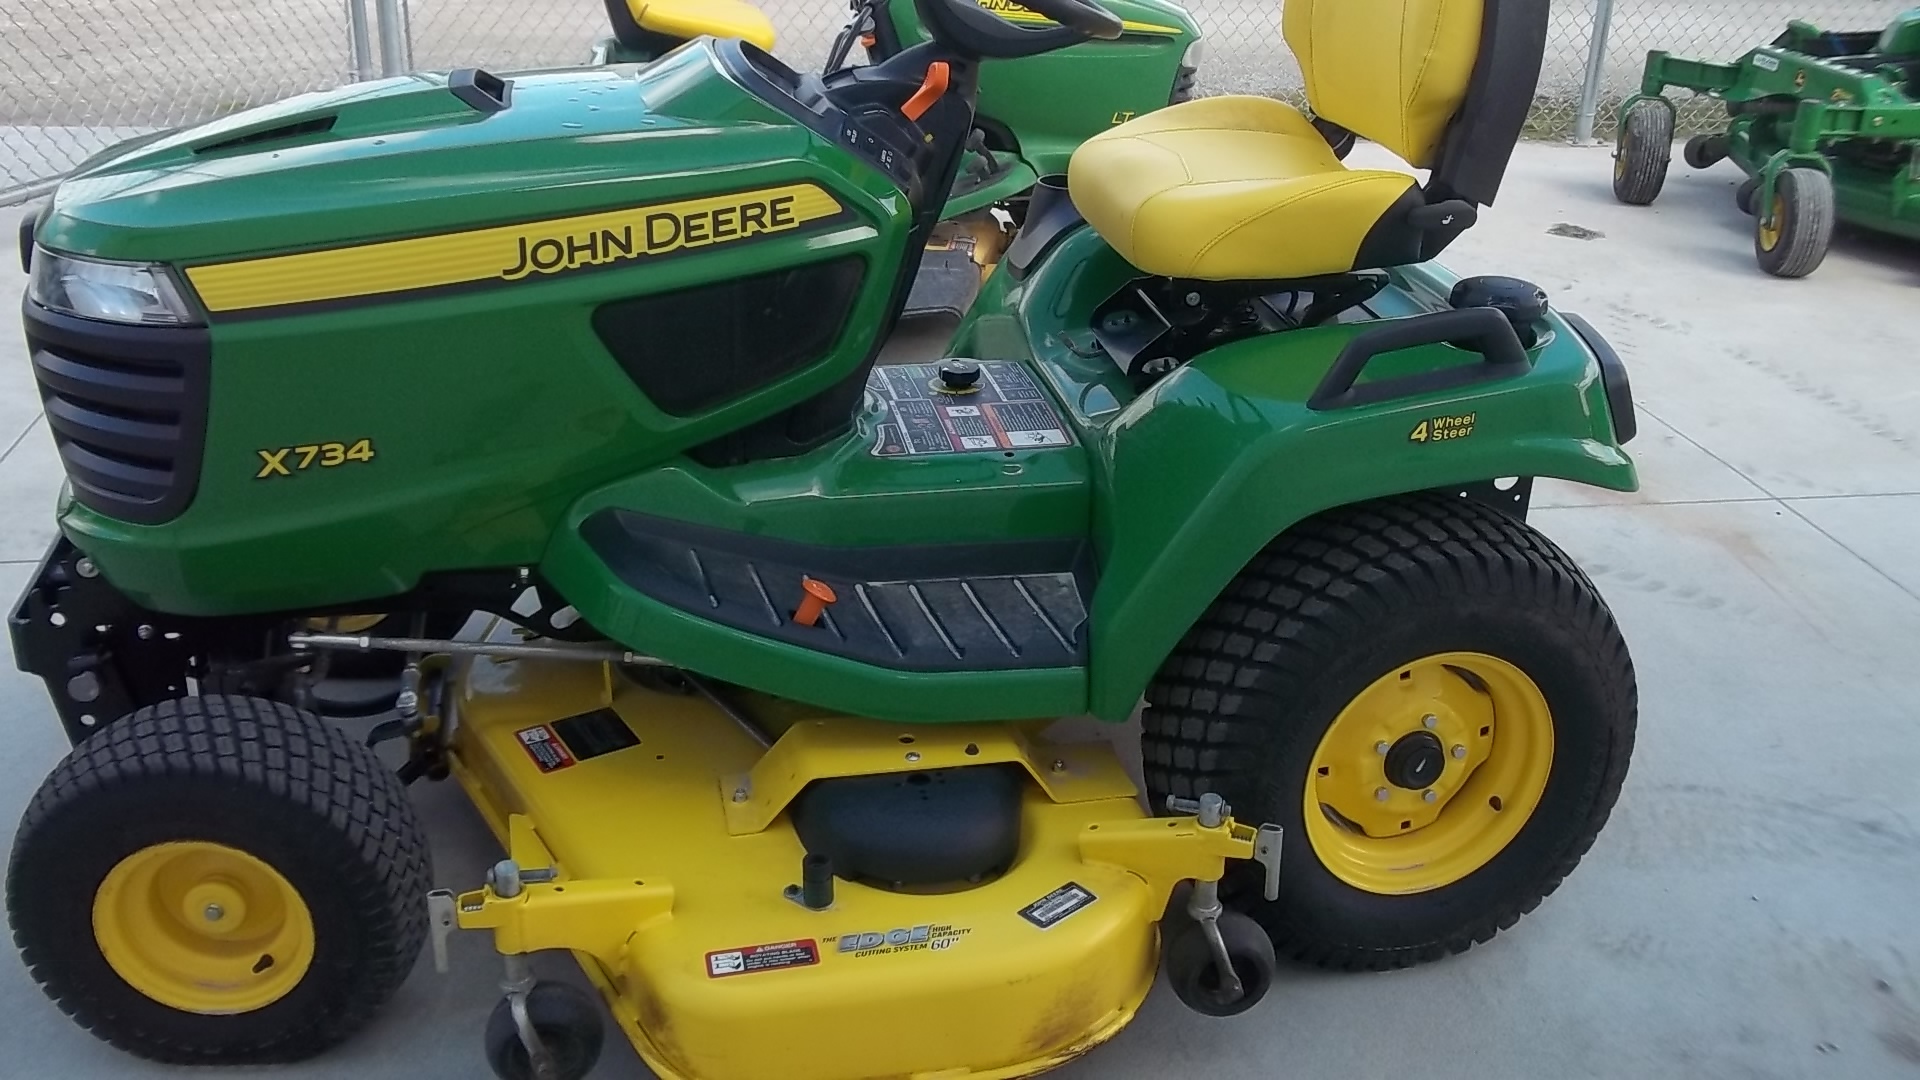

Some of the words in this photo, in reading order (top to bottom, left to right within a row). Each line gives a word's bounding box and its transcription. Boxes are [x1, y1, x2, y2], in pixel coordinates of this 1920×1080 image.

[502, 225, 633, 276] JOHN
[645, 195, 795, 250] DEERE
[1410, 420, 1428, 442] 4
[1432, 411, 1476, 430] Wheel
[1432, 426, 1473, 442] Steer
[256, 438, 375, 478] X734
[931, 928, 972, 939] CAPACITY
[932, 925, 952, 933] HIGH
[764, 942, 797, 951] DANGER
[838, 925, 931, 953] EDGE
[855, 947, 892, 958] CUTTING
[893, 943, 928, 953] SYSTEM
